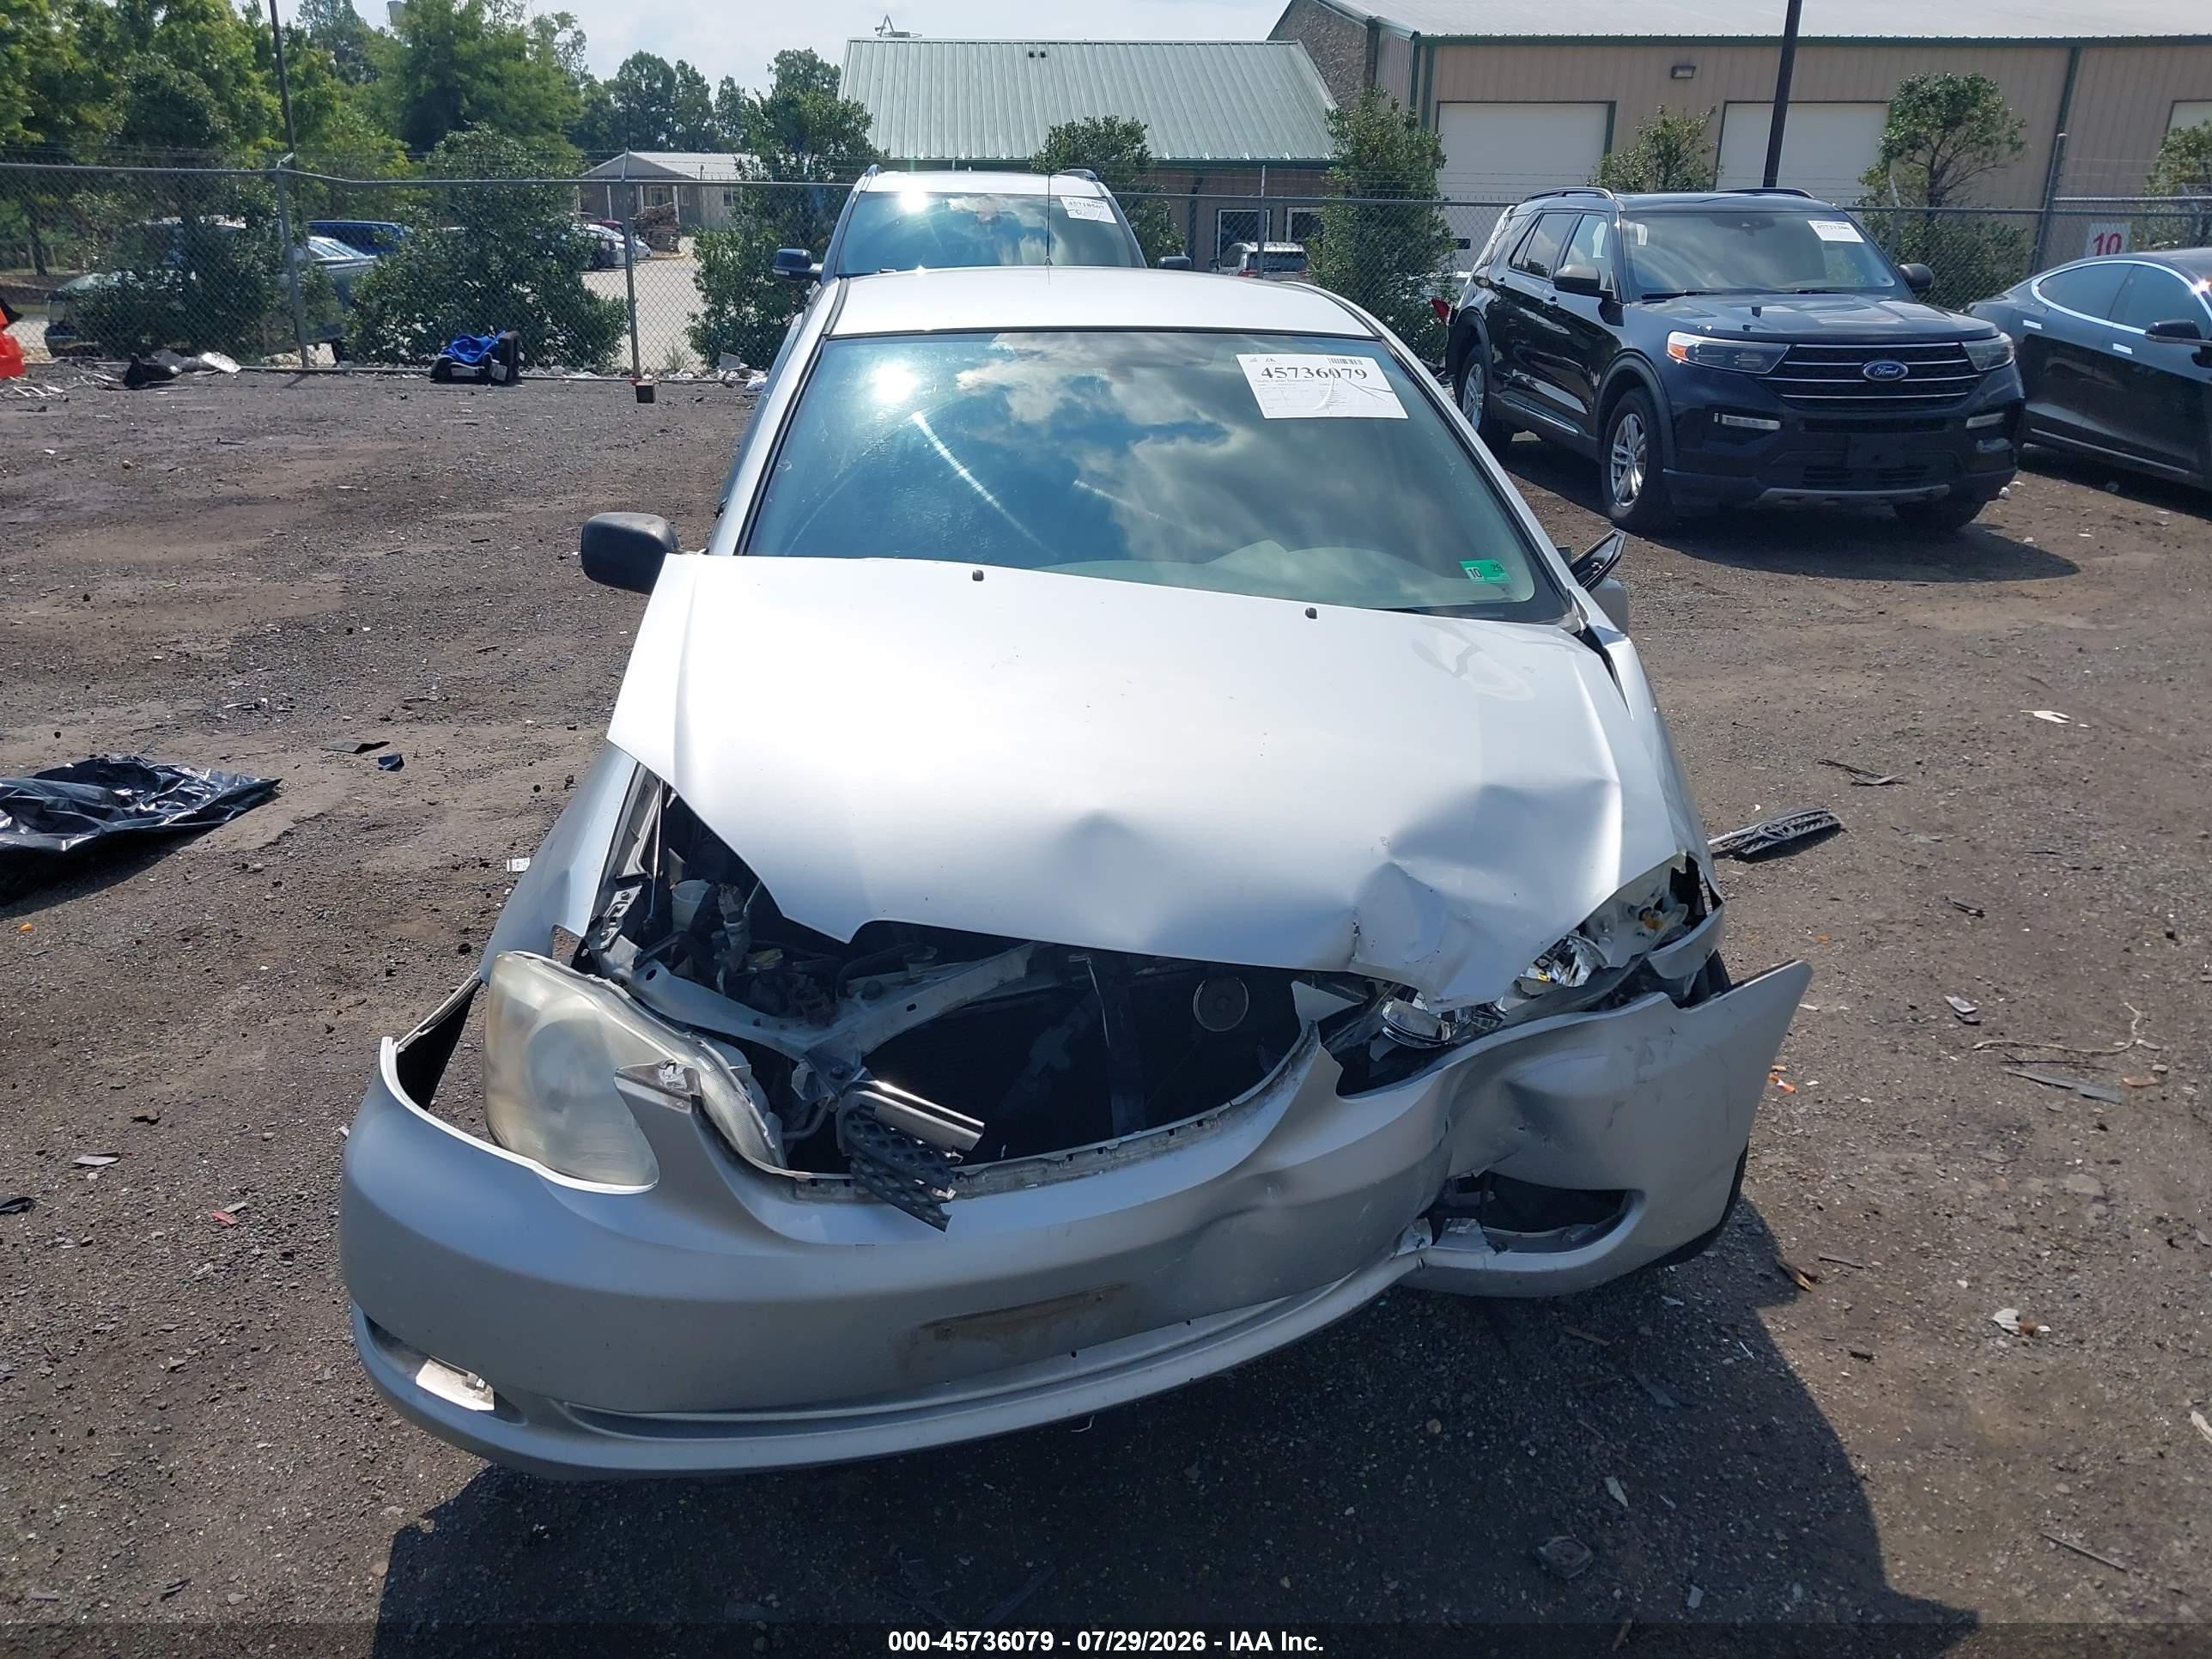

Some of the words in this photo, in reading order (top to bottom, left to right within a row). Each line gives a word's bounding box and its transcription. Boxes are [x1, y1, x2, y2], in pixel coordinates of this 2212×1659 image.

[2093, 233, 2123, 256] 10
[1261, 367, 1368, 380] 45736079
[1875, 365, 1899, 376] Ford
[1468, 568, 1483, 579] 10
